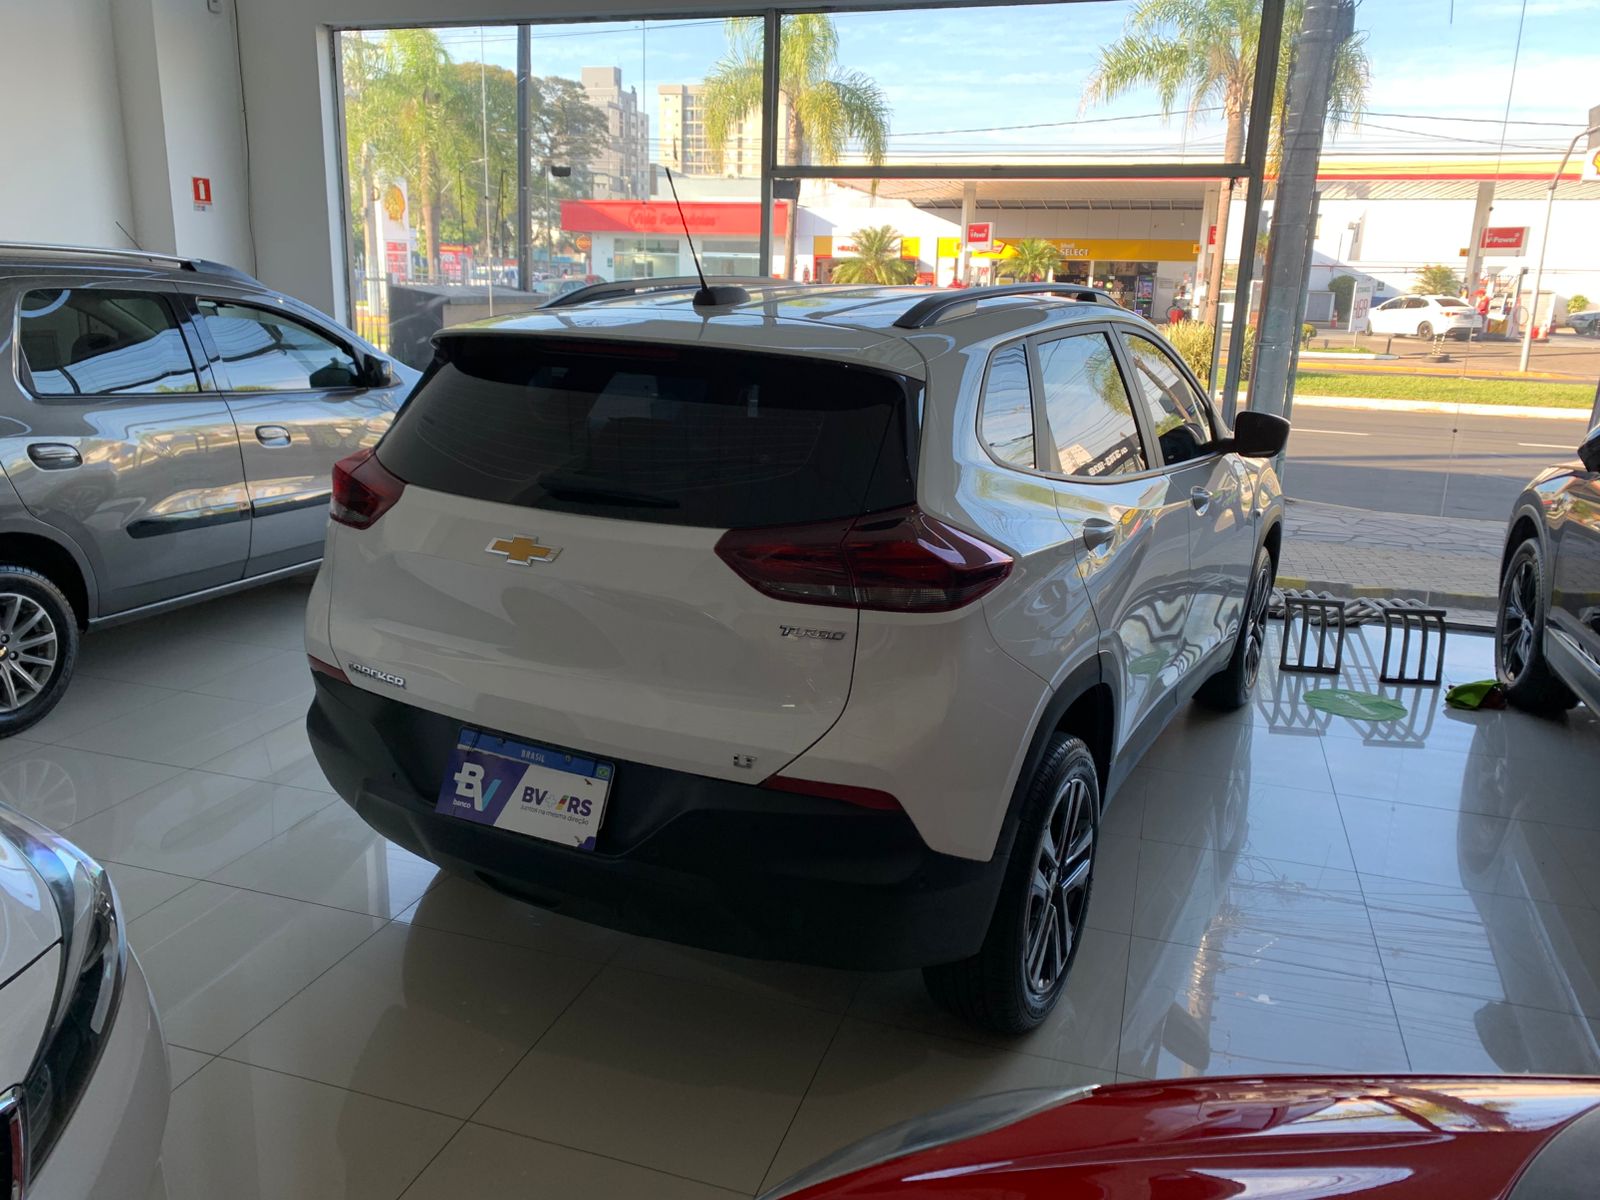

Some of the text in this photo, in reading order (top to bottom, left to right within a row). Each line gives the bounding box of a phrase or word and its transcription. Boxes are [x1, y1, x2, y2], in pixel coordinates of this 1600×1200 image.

[1060, 248, 1088, 256] SELECT
[779, 623, 847, 641] TURBO
[520, 749, 545, 763] BRASIL
[452, 798, 472, 809] banco
[567, 797, 593, 816] RS
[567, 814, 589, 826] direção
